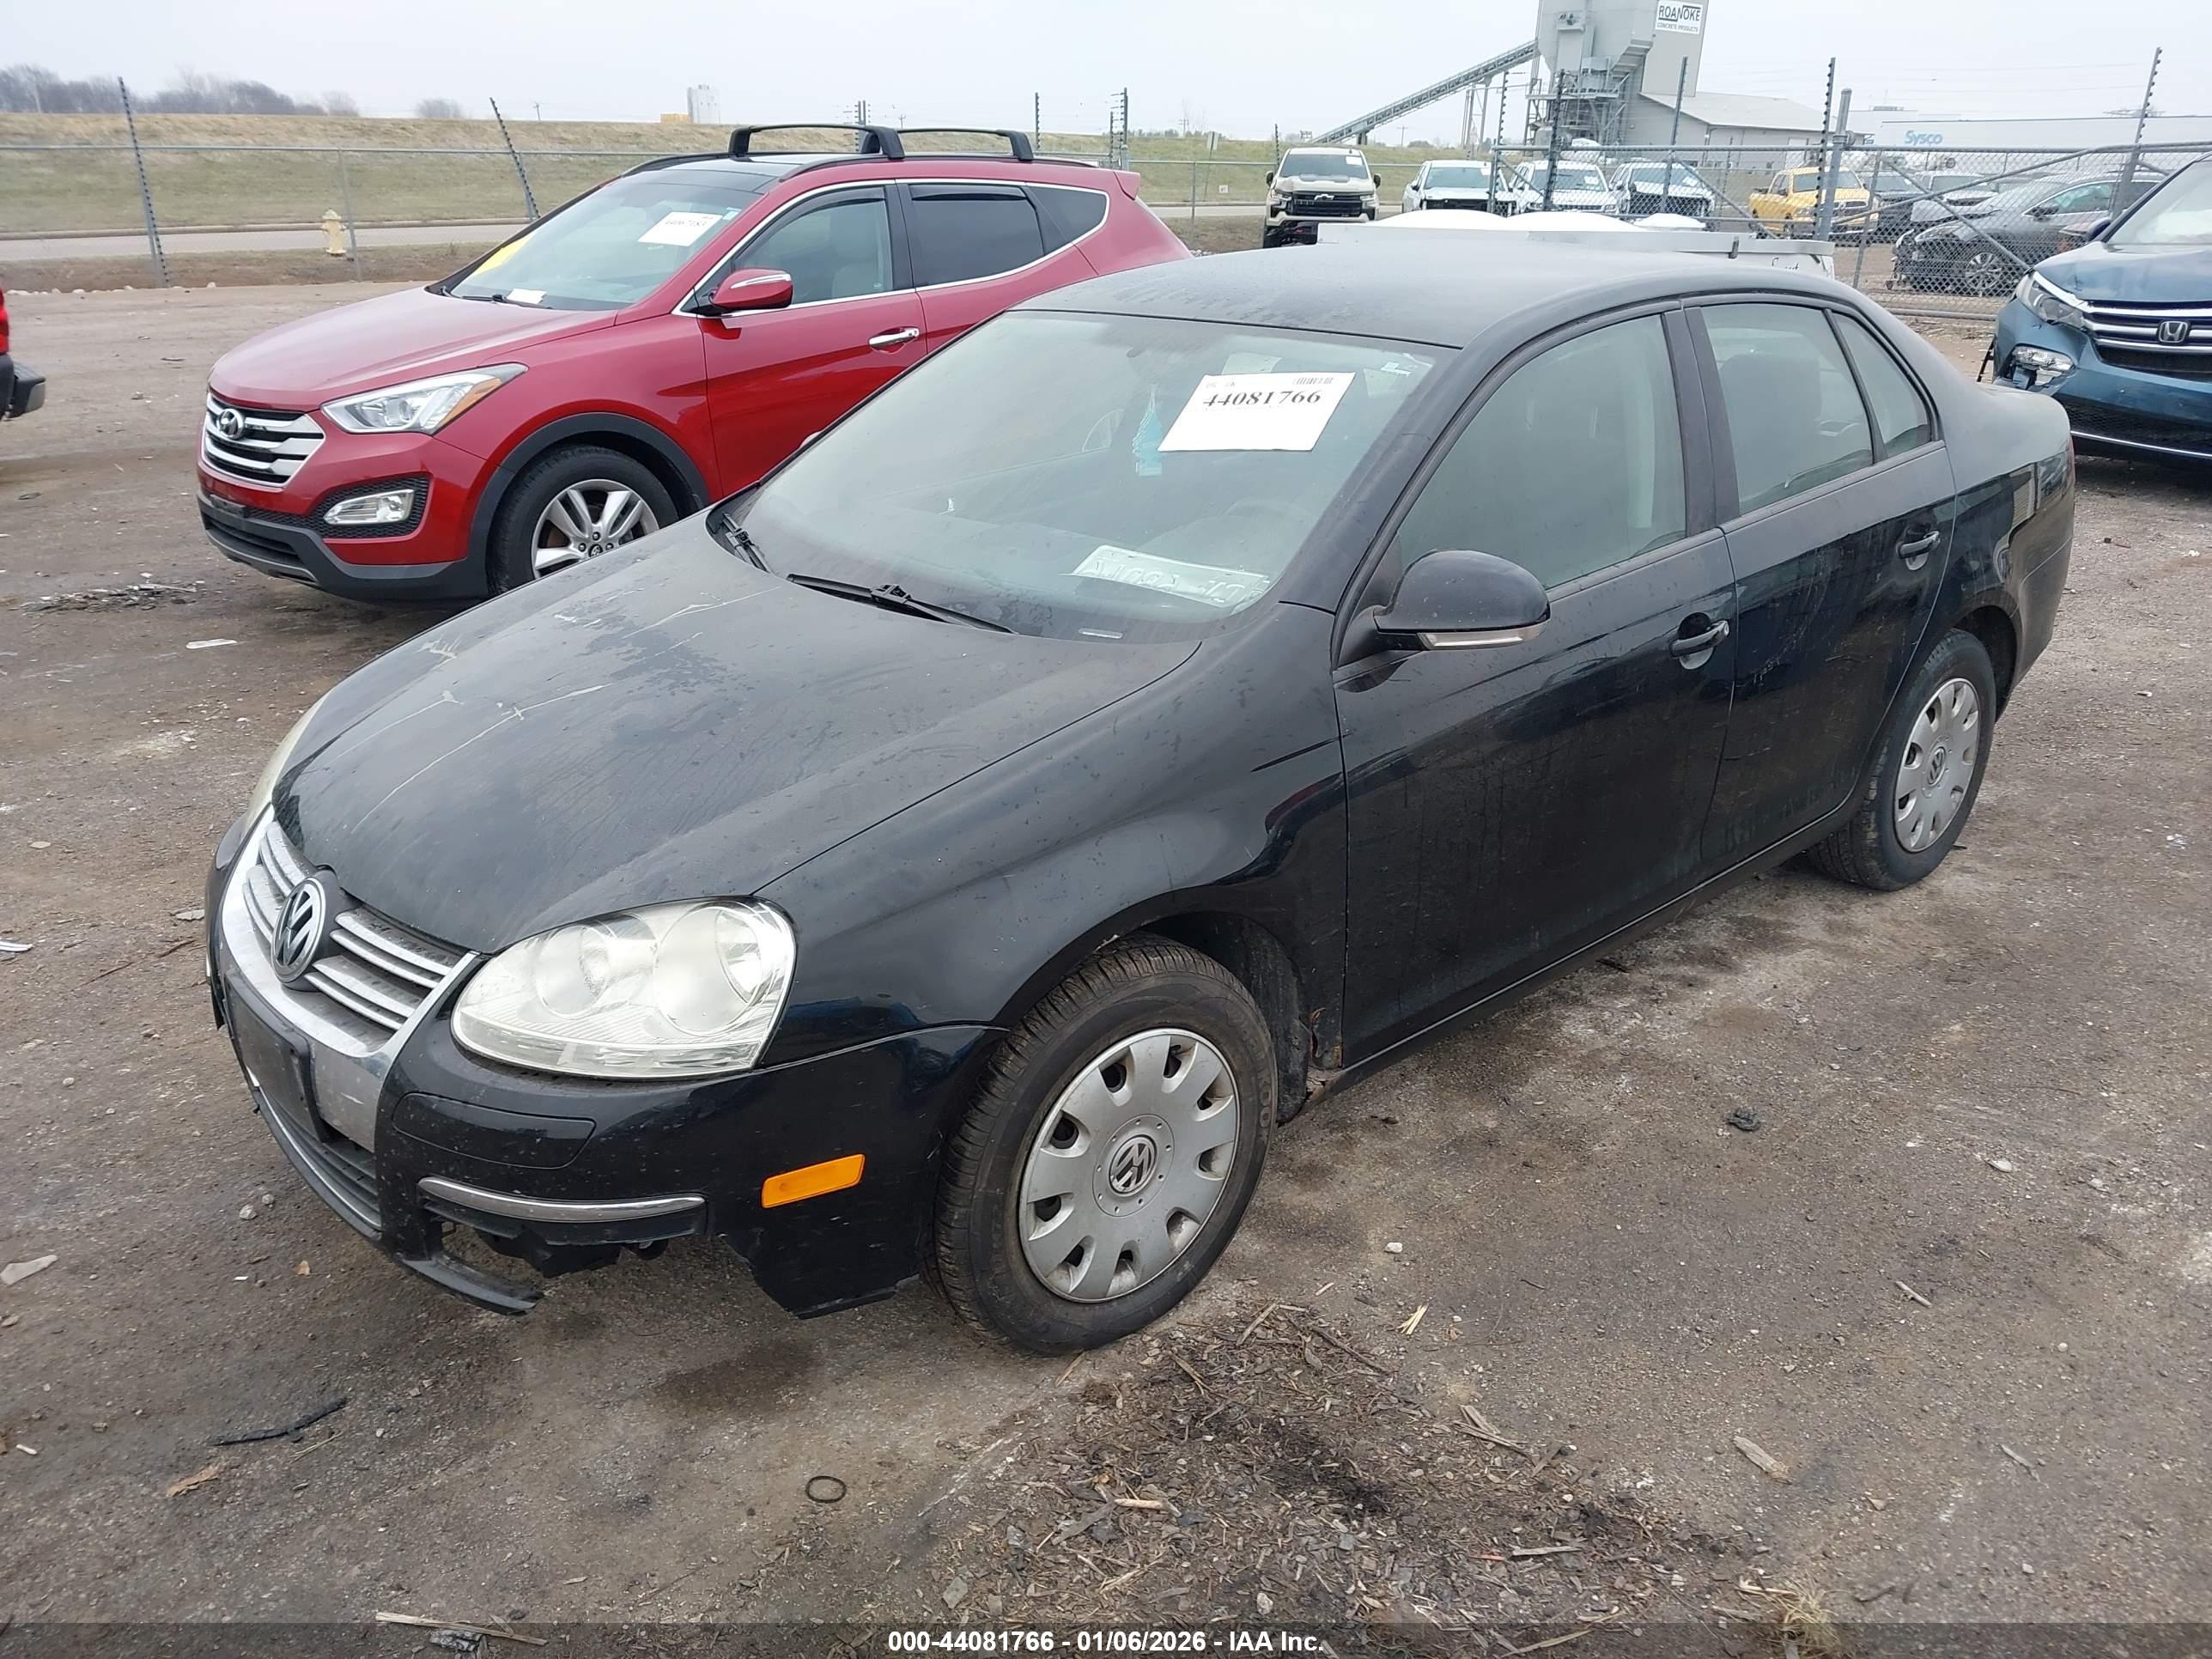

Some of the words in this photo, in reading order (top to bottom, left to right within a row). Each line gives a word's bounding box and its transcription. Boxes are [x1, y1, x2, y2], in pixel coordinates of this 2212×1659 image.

[1658, 5, 1701, 21] ROANOKE
[1905, 130, 1944, 147] Sysco
[1203, 390, 1321, 407] 44081766
